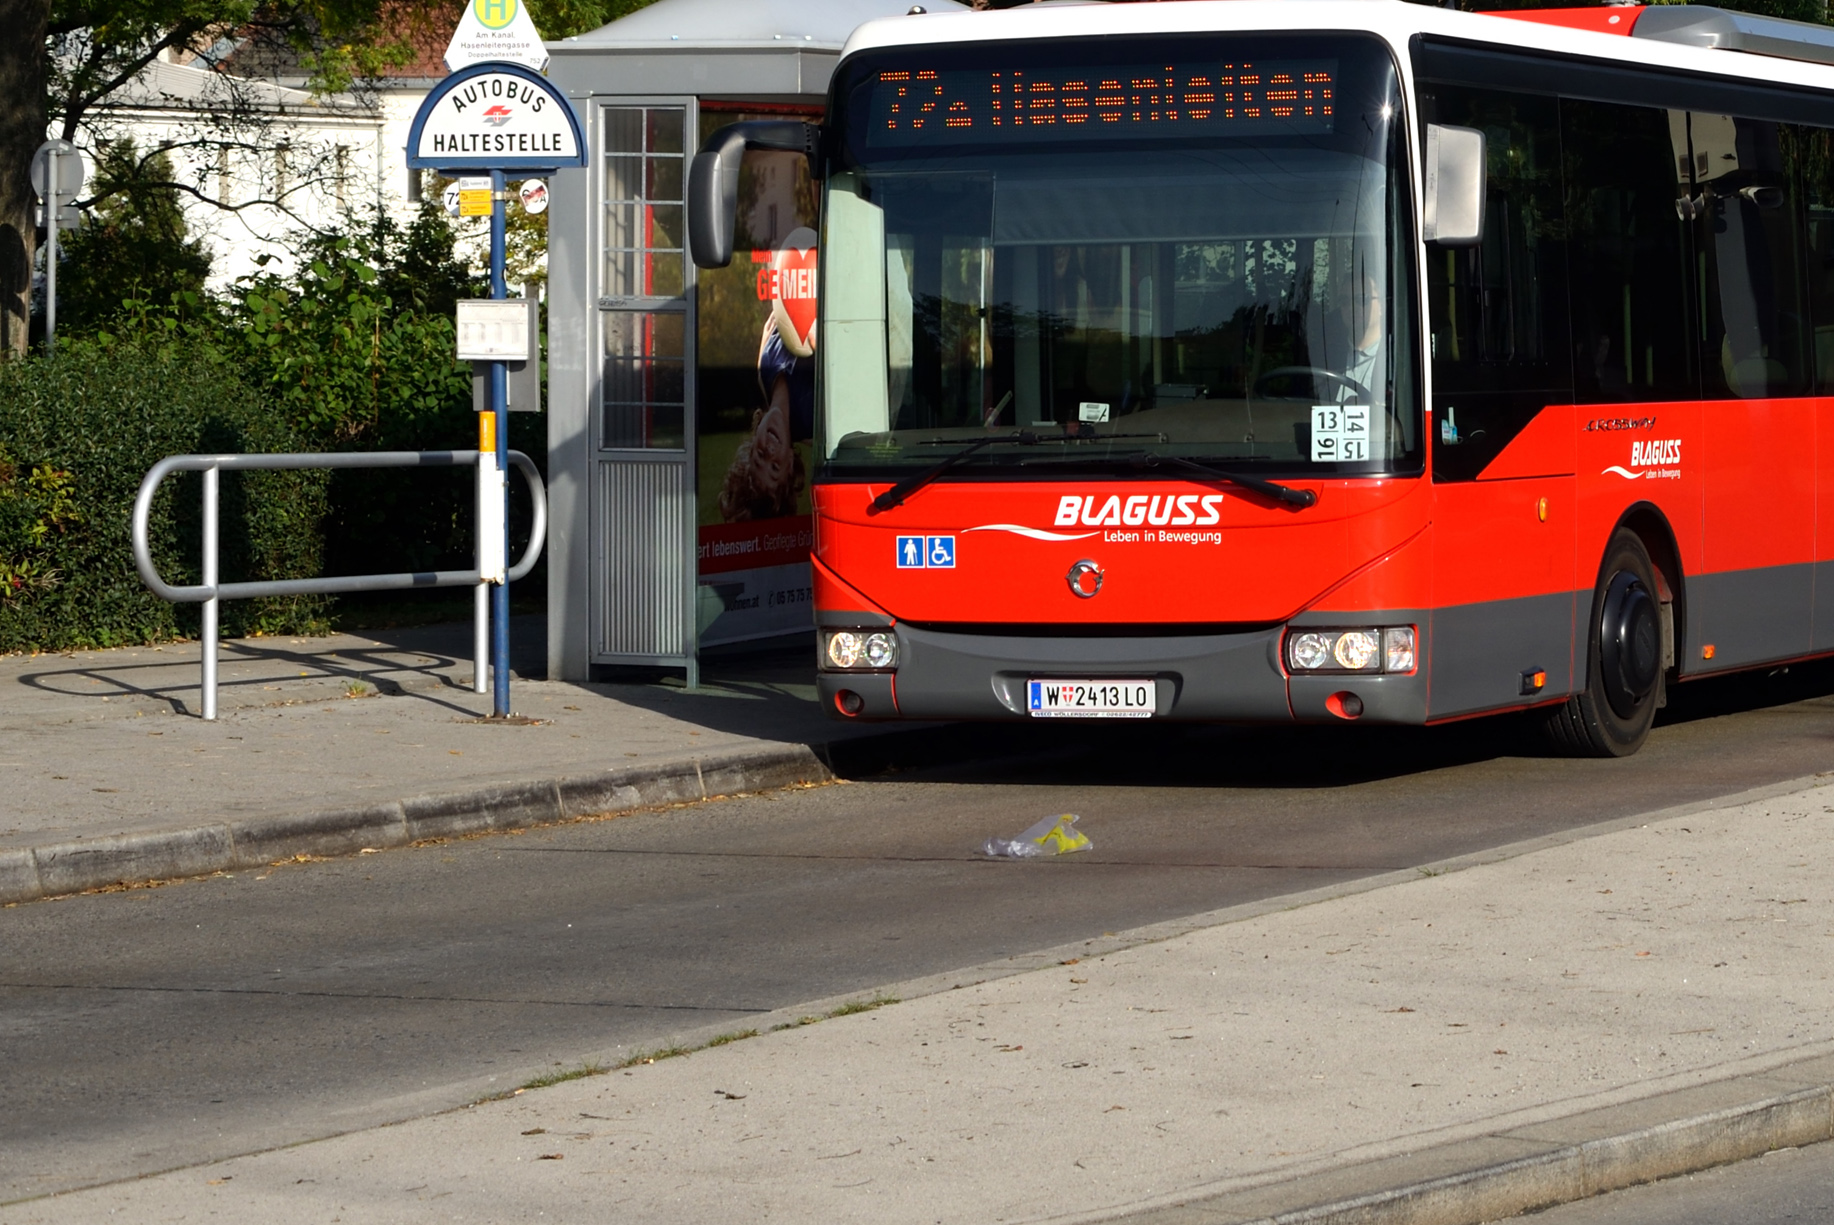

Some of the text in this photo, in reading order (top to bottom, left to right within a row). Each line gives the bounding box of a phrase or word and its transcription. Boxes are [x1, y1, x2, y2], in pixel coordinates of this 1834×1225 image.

[491, 31, 516, 39] Kanal,
[460, 42, 531, 50] Hasenleitengasse
[451, 78, 546, 114] AUTOBUS
[433, 133, 563, 152] HALTESTELLE
[521, 188, 547, 204] 6A
[751, 248, 773, 263] Mein
[1317, 411, 1338, 430] 13
[1346, 411, 1365, 433] 14
[1584, 415, 1657, 433] CROSSWAY
[1317, 437, 1336, 459] 16
[1344, 441, 1365, 459] 15
[1630, 439, 1682, 467] BLAGUSS
[1645, 468, 1682, 480] Leben in Bewegung
[1053, 495, 1224, 526] BLAGUSS
[711, 536, 762, 557] lebenswert.
[1104, 529, 1222, 545] Leben in Bewegung
[1033, 699, 1040, 707] A
[1046, 686, 1060, 706] W
